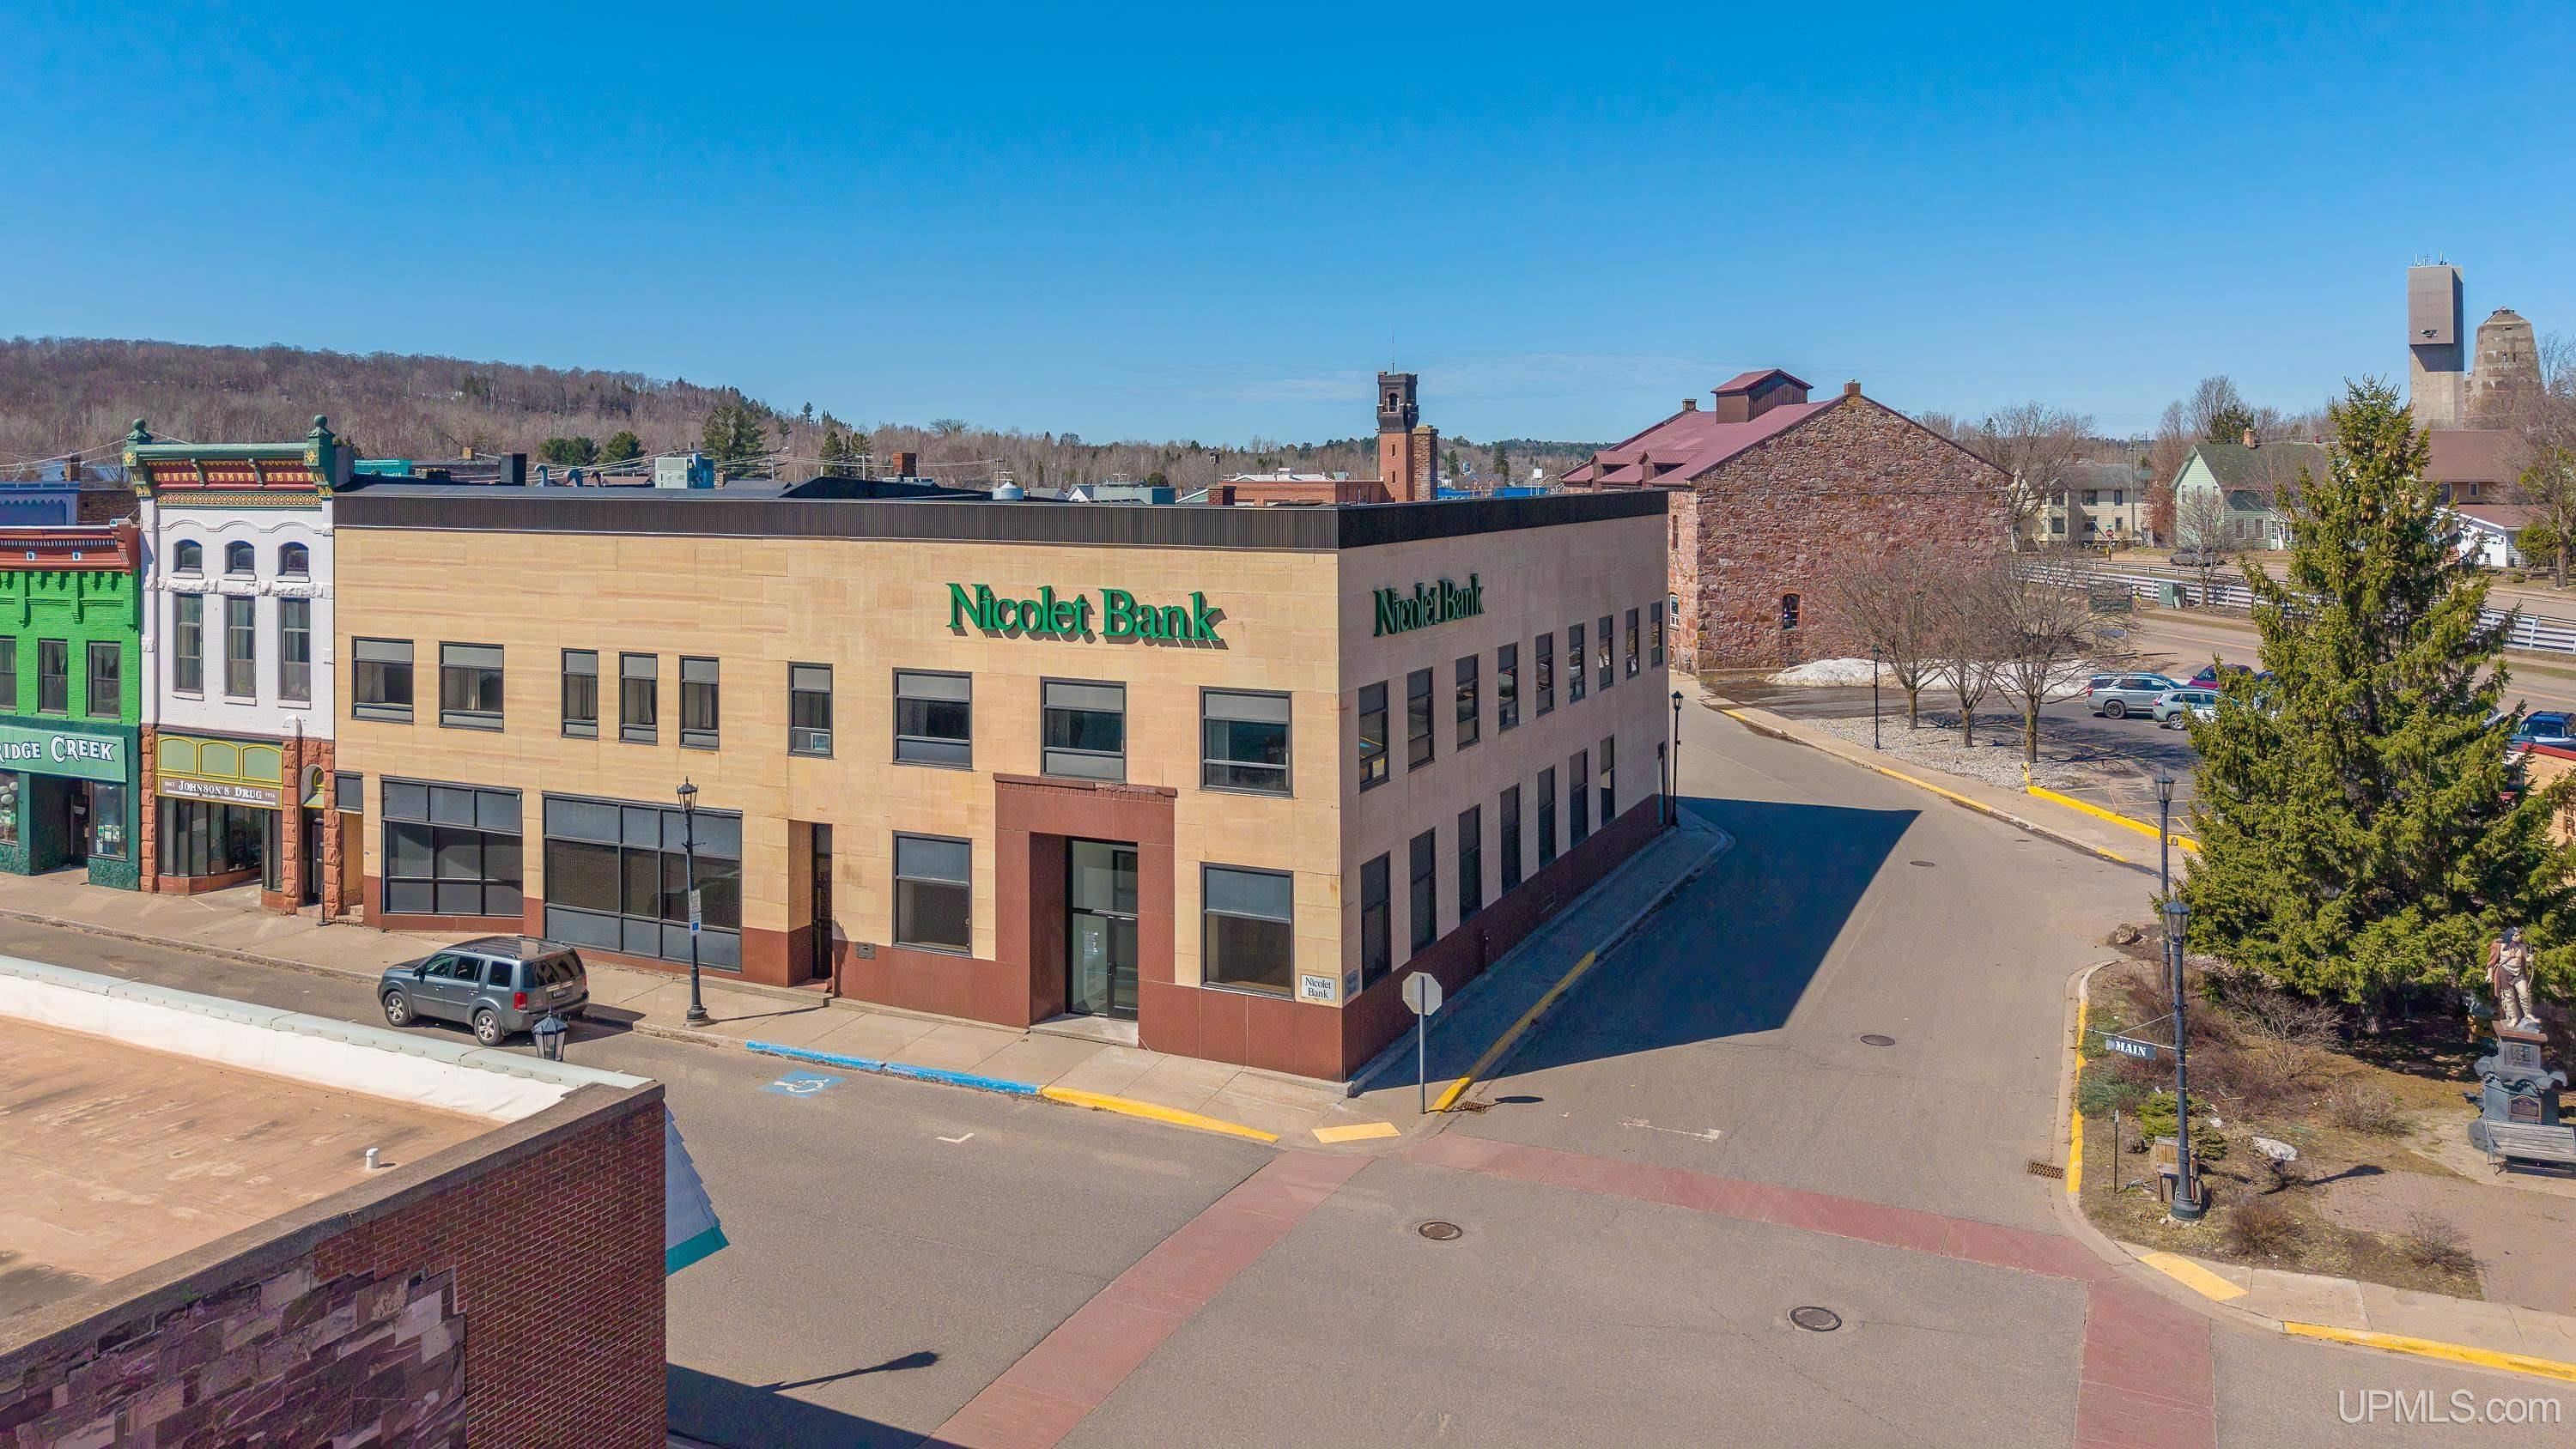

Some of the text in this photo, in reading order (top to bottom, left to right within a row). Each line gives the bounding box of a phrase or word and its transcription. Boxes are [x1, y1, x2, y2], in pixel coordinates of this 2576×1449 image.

[945, 582, 1224, 642] Nicolet Bank
[1373, 573, 1485, 637] Nicolet Bank
[50, 735, 118, 763] CREEK
[178, 780, 230, 796] JOHNSON'S
[234, 786, 263, 799] DRUG
[1305, 977, 1331, 989] Nicolet
[1308, 987, 1328, 998] Bank
[2115, 1040, 2147, 1057] MAIN
